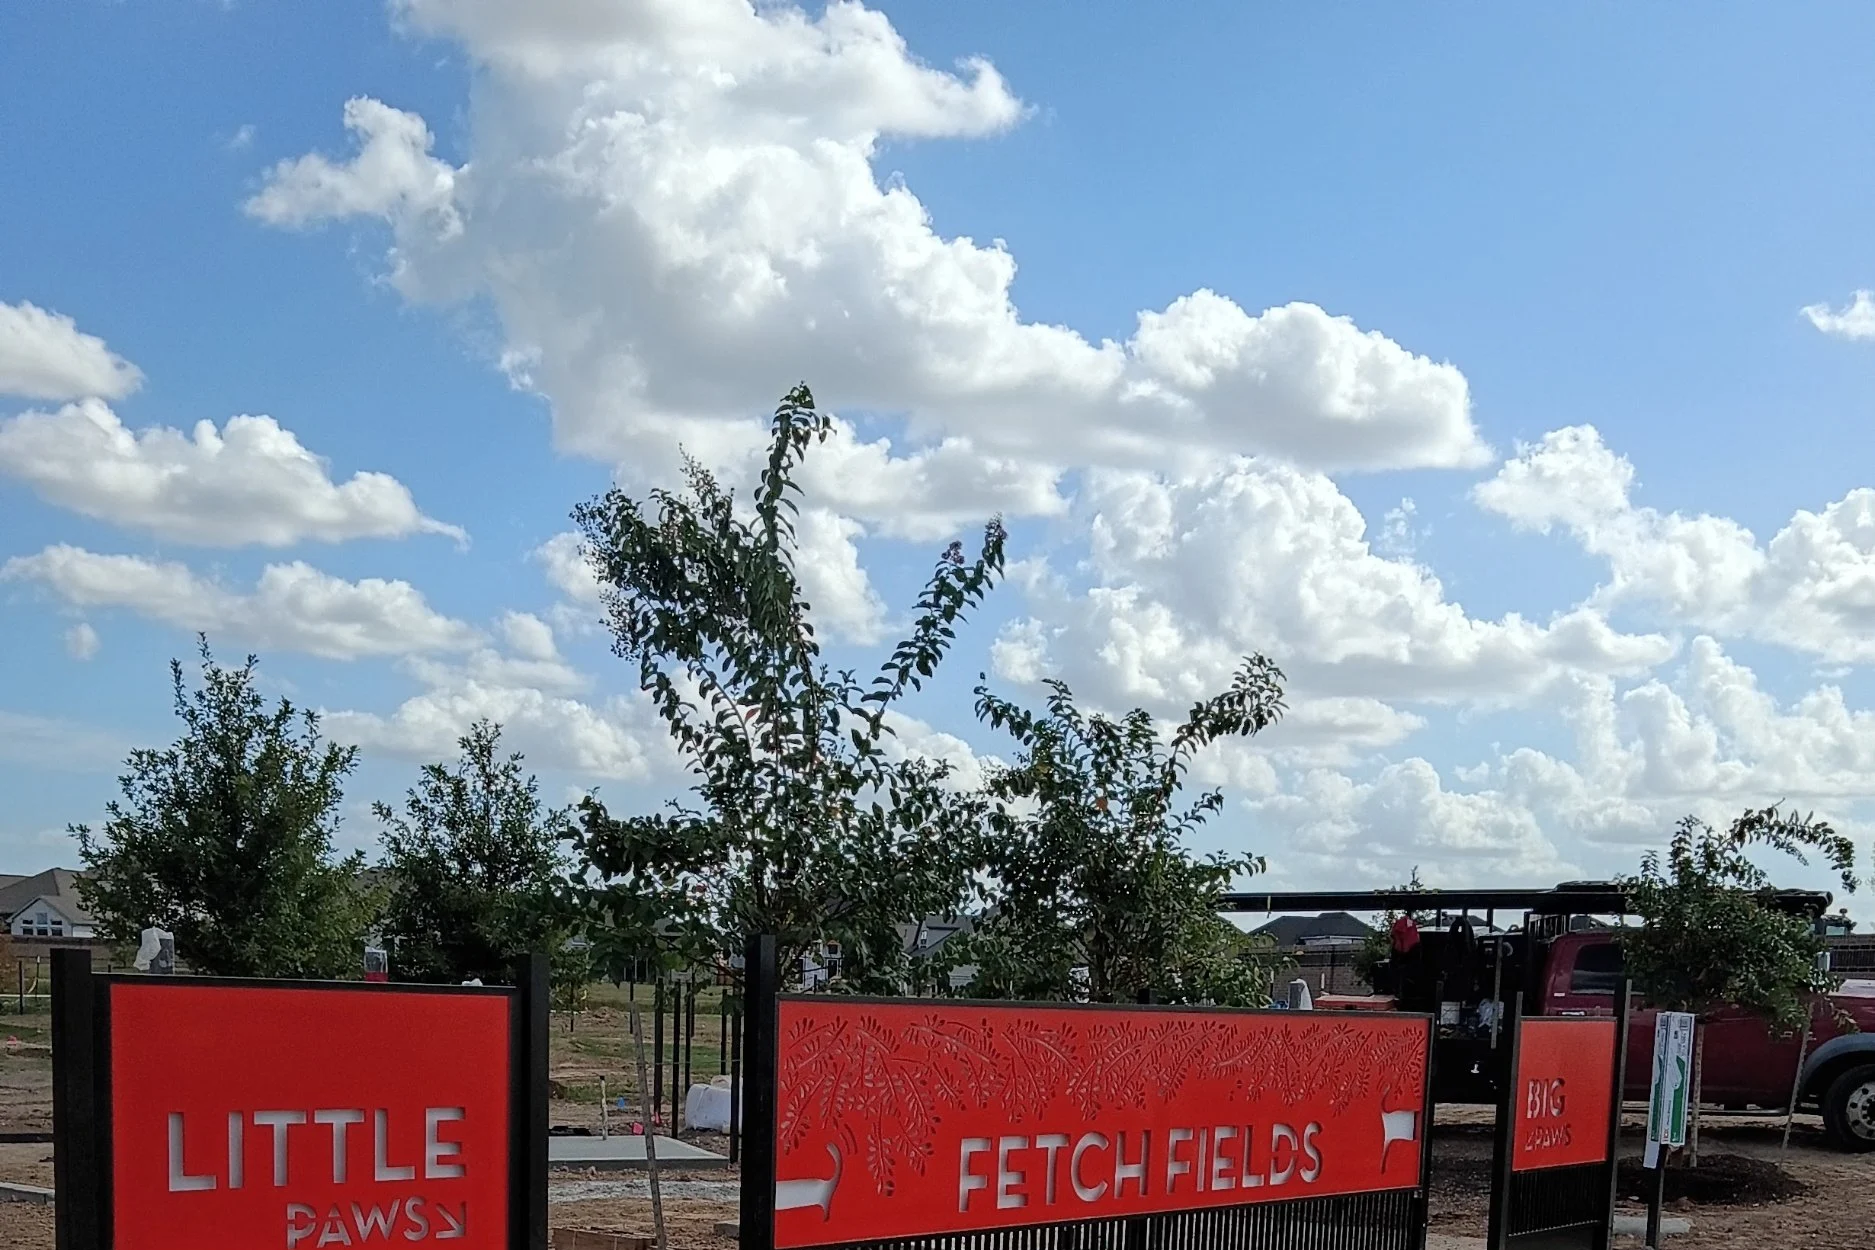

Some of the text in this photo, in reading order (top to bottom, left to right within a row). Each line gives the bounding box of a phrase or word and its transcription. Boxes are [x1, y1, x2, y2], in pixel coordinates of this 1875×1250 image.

[1526, 1078, 1566, 1119] BIG
[167, 1107, 466, 1192] LITTLE
[1534, 1123, 1572, 1151] PAWS
[958, 1121, 1324, 1212] FETCH FIELDS
[286, 1196, 430, 1250] PAWS
